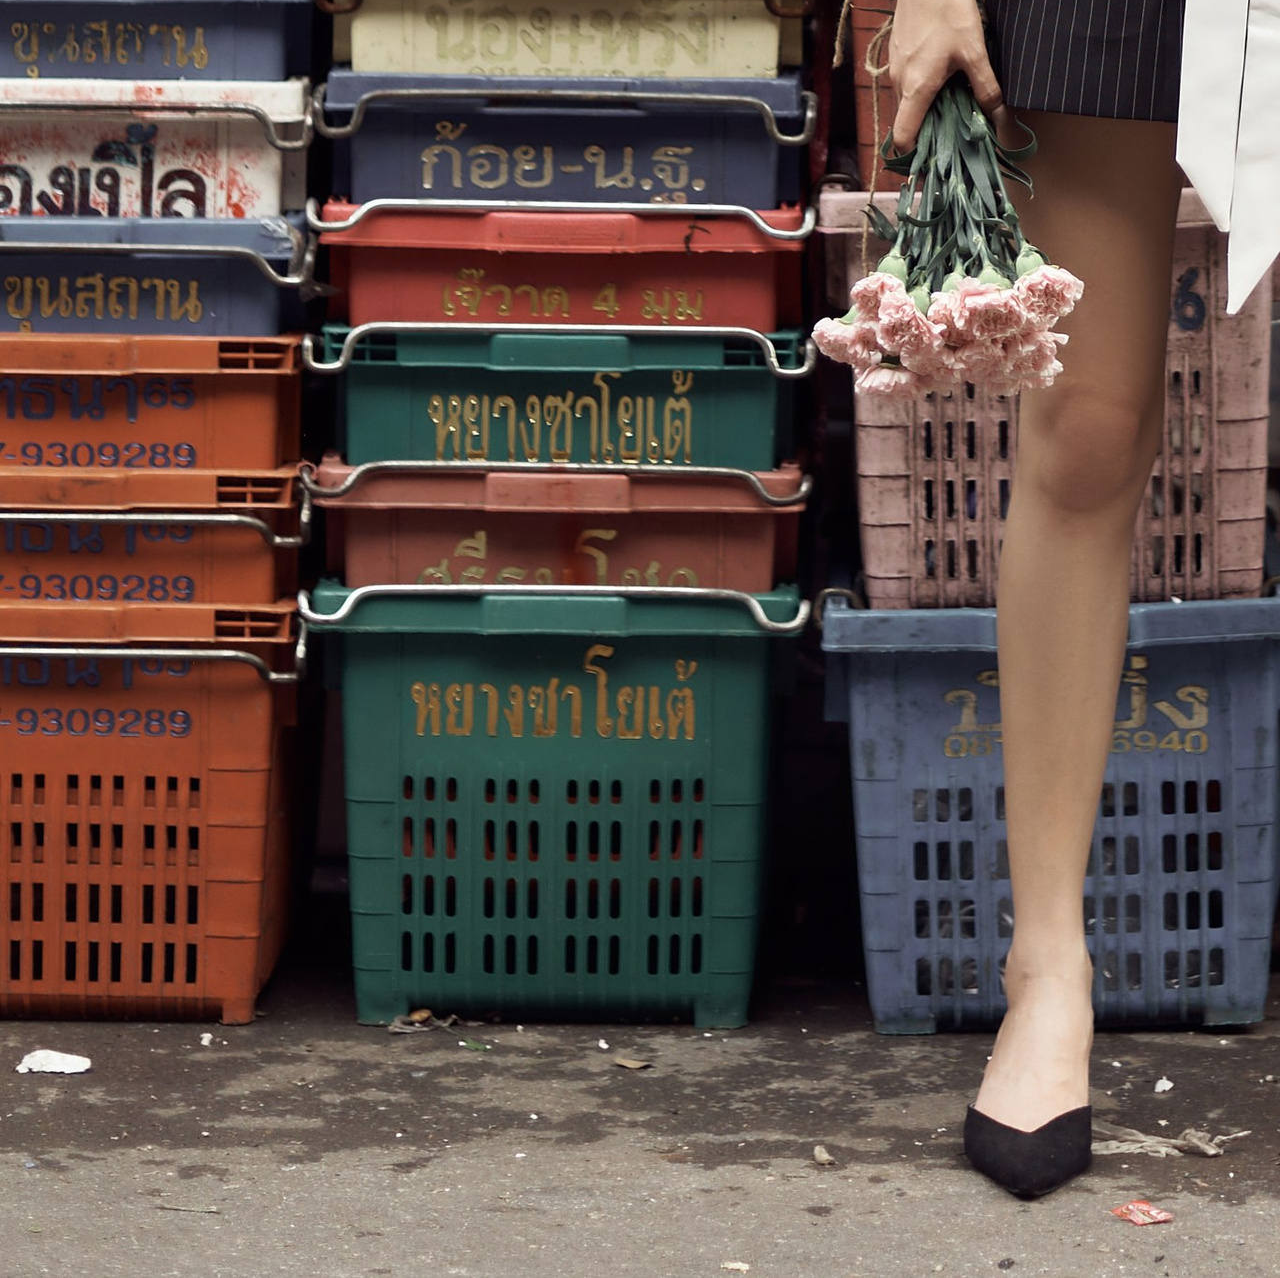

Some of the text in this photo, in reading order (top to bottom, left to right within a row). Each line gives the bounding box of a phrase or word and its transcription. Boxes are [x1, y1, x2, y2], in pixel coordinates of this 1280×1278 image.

[5, 275, 202, 331] ขุนสถาน
[593, 282, 619, 318] 4
[0, 441, 196, 469] -9309289
[0, 574, 195, 603] -9309289
